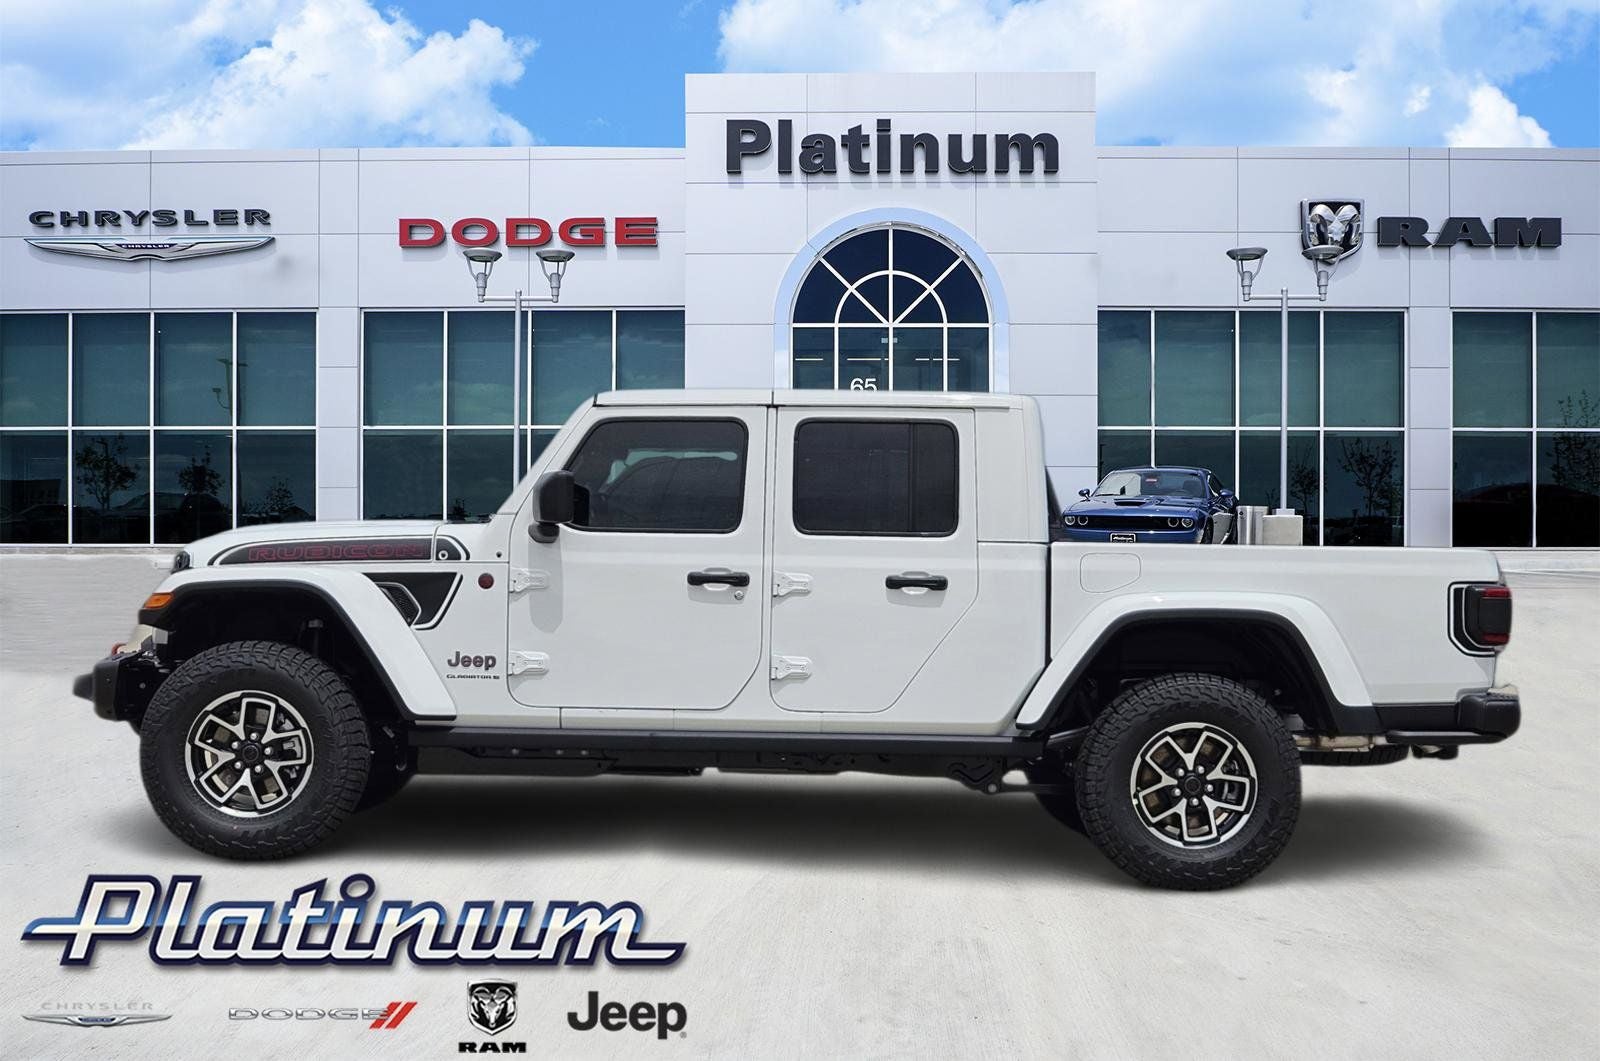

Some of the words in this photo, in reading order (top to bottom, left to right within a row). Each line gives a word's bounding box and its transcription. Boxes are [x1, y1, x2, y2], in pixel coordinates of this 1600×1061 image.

[726, 119, 1059, 174] Platinum
[29, 209, 271, 227] CHRYSLER
[399, 217, 658, 247] DODGE
[1377, 217, 1562, 248] RAM
[248, 543, 429, 562] RUBICON
[447, 651, 496, 671] Jeep
